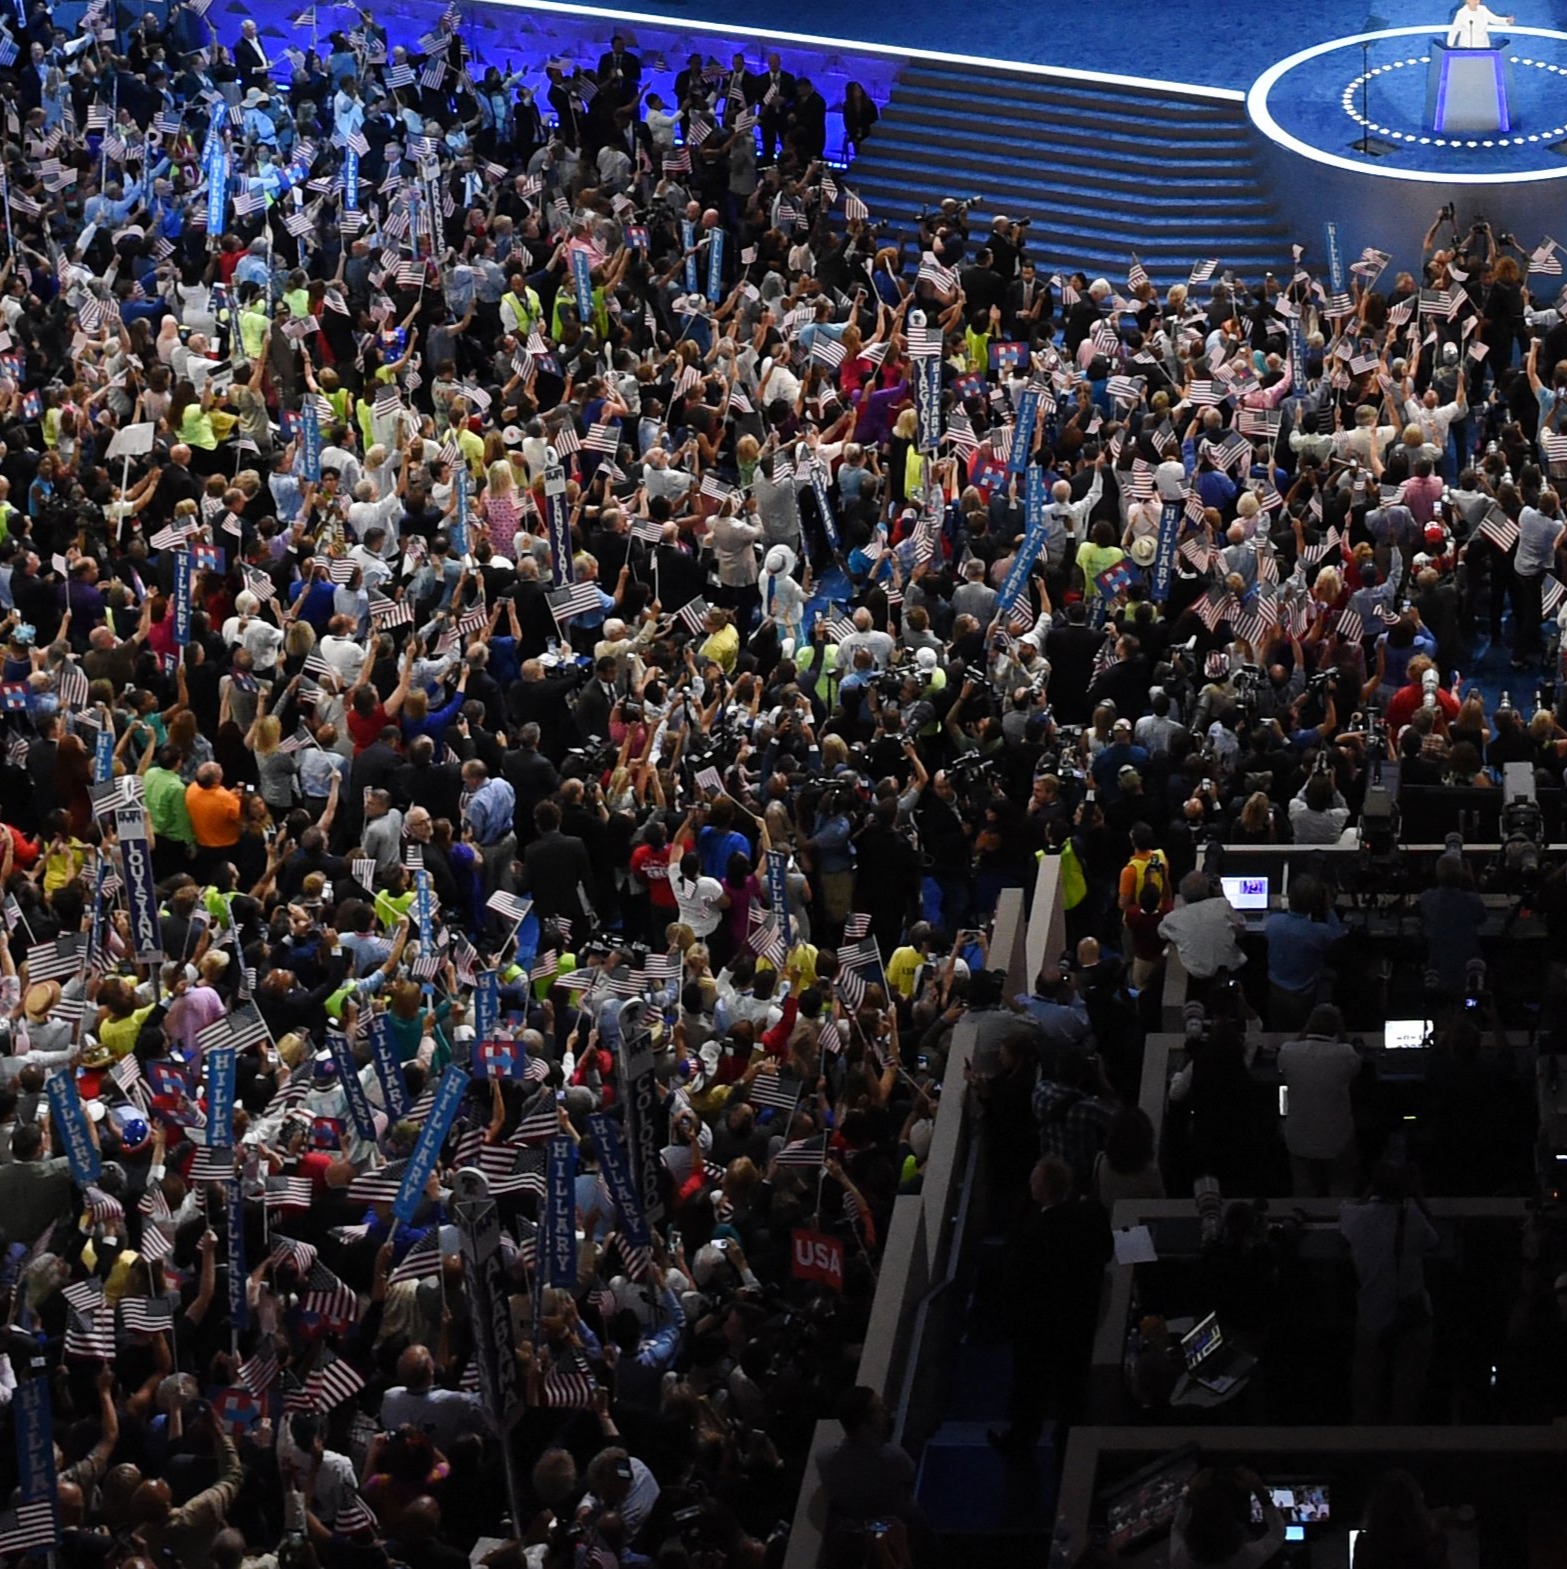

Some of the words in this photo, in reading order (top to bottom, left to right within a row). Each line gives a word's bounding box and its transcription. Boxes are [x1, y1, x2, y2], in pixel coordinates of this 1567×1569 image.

[212, 159, 222, 225] HILLARY
[575, 251, 589, 314] HILLARY
[710, 231, 721, 293] HILLARY
[1328, 224, 1340, 289] HILLARY
[1290, 319, 1302, 391] HILLARY
[917, 356, 931, 444] VIRGINIA
[931, 361, 941, 438] HILLARY
[1015, 393, 1037, 468] HILLARY
[305, 408, 319, 474] HILLARY
[1029, 473, 1039, 523] HILLA
[1002, 527, 1041, 600] HILLARY
[1158, 509, 1175, 591] HILLARY
[177, 553, 188, 635] HILLARY
[96, 734, 108, 782] HILL
[128, 841, 155, 951] LOUISIANA
[479, 977, 493, 1032] HILL
[211, 1055, 228, 1146] HILLA
[334, 1040, 369, 1129] HILLARY
[372, 1017, 404, 1116] HILLARY
[53, 1077, 90, 1173] HILLARY
[403, 1074, 461, 1202] HILLARY
[636, 1074, 659, 1211] COLORADO
[553, 1141, 572, 1271] HILLARY
[592, 1119, 641, 1233] HILLARY
[227, 1184, 241, 1313] HILLARY
[796, 1238, 842, 1278] USA
[485, 1254, 519, 1418] ALABAMA
[24, 1385, 50, 1492] HILLA
